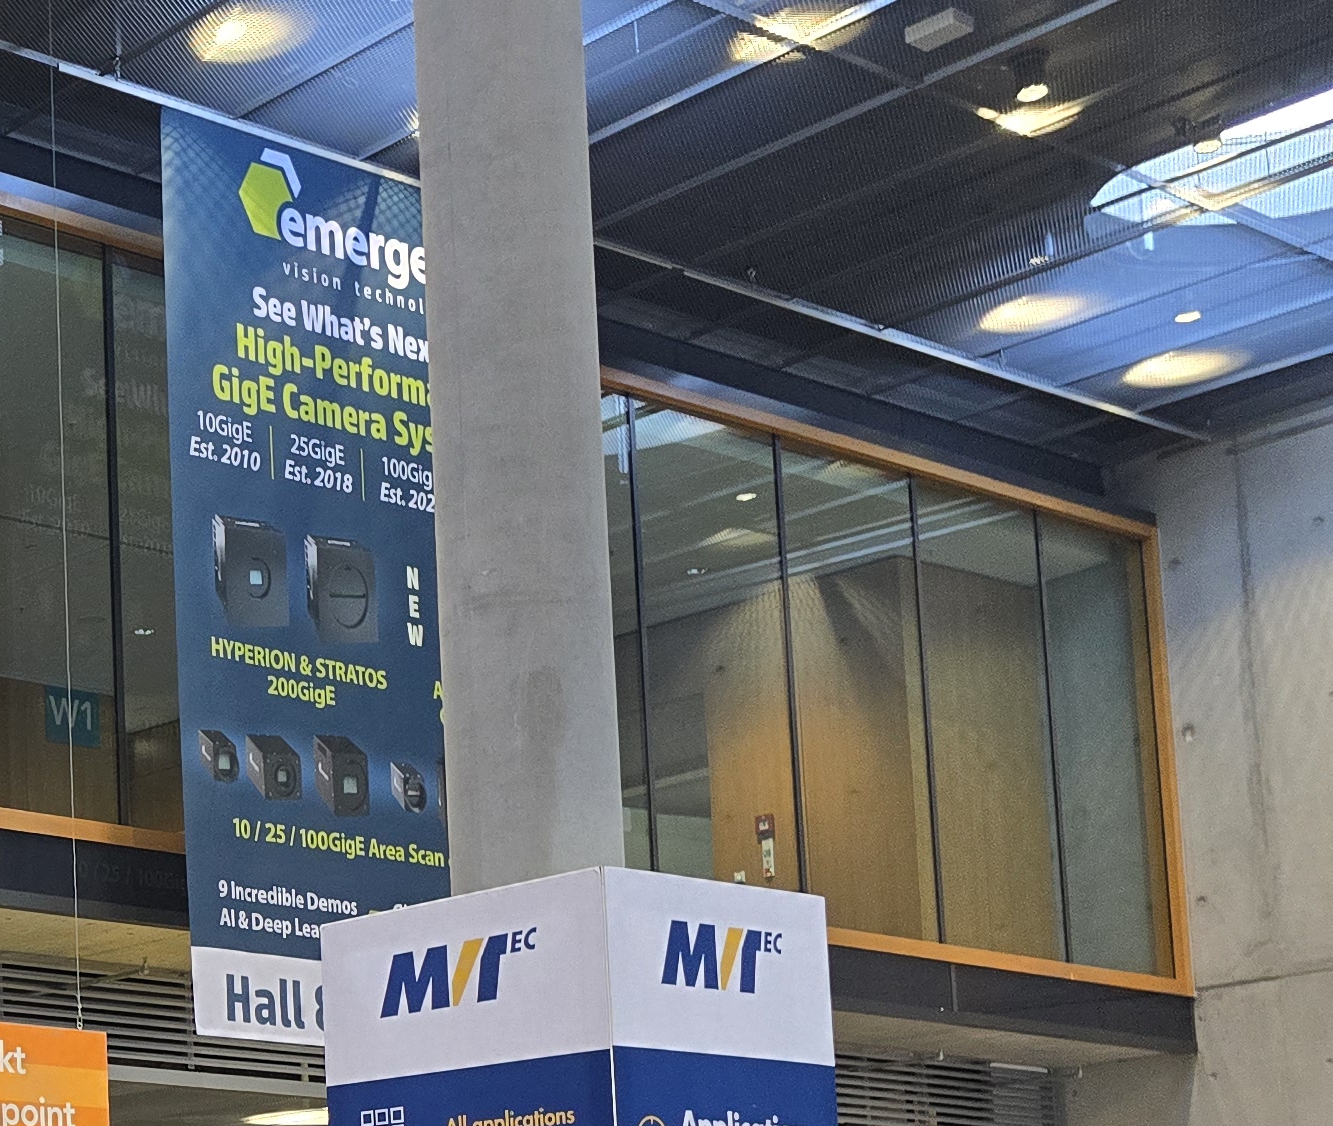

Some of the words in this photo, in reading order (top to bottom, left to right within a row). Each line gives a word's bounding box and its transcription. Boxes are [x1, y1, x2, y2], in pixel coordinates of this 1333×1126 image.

[283, 262, 341, 291] vision
[253, 287, 296, 327] See
[212, 364, 276, 415] GigE
[283, 383, 386, 441] Camera
[197, 411, 253, 443] 10GigE
[190, 436, 218, 460] Est.
[222, 445, 261, 472] 2010
[290, 434, 345, 466] 25GigE
[285, 459, 312, 485] Est.
[315, 468, 353, 493] 2018
[210, 637, 297, 674] HYPERION
[315, 658, 388, 690] STRATOS
[267, 675, 336, 709] 200GigE
[49, 694, 92, 730] W1
[265, 825, 286, 845] 25
[300, 829, 365, 860] 100GigE
[369, 837, 405, 862] Area
[408, 842, 445, 868] Scan
[231, 883, 303, 910] Incredible
[306, 892, 358, 916] Demos
[251, 913, 291, 940] Deep
[225, 973, 307, 1029] Hall
